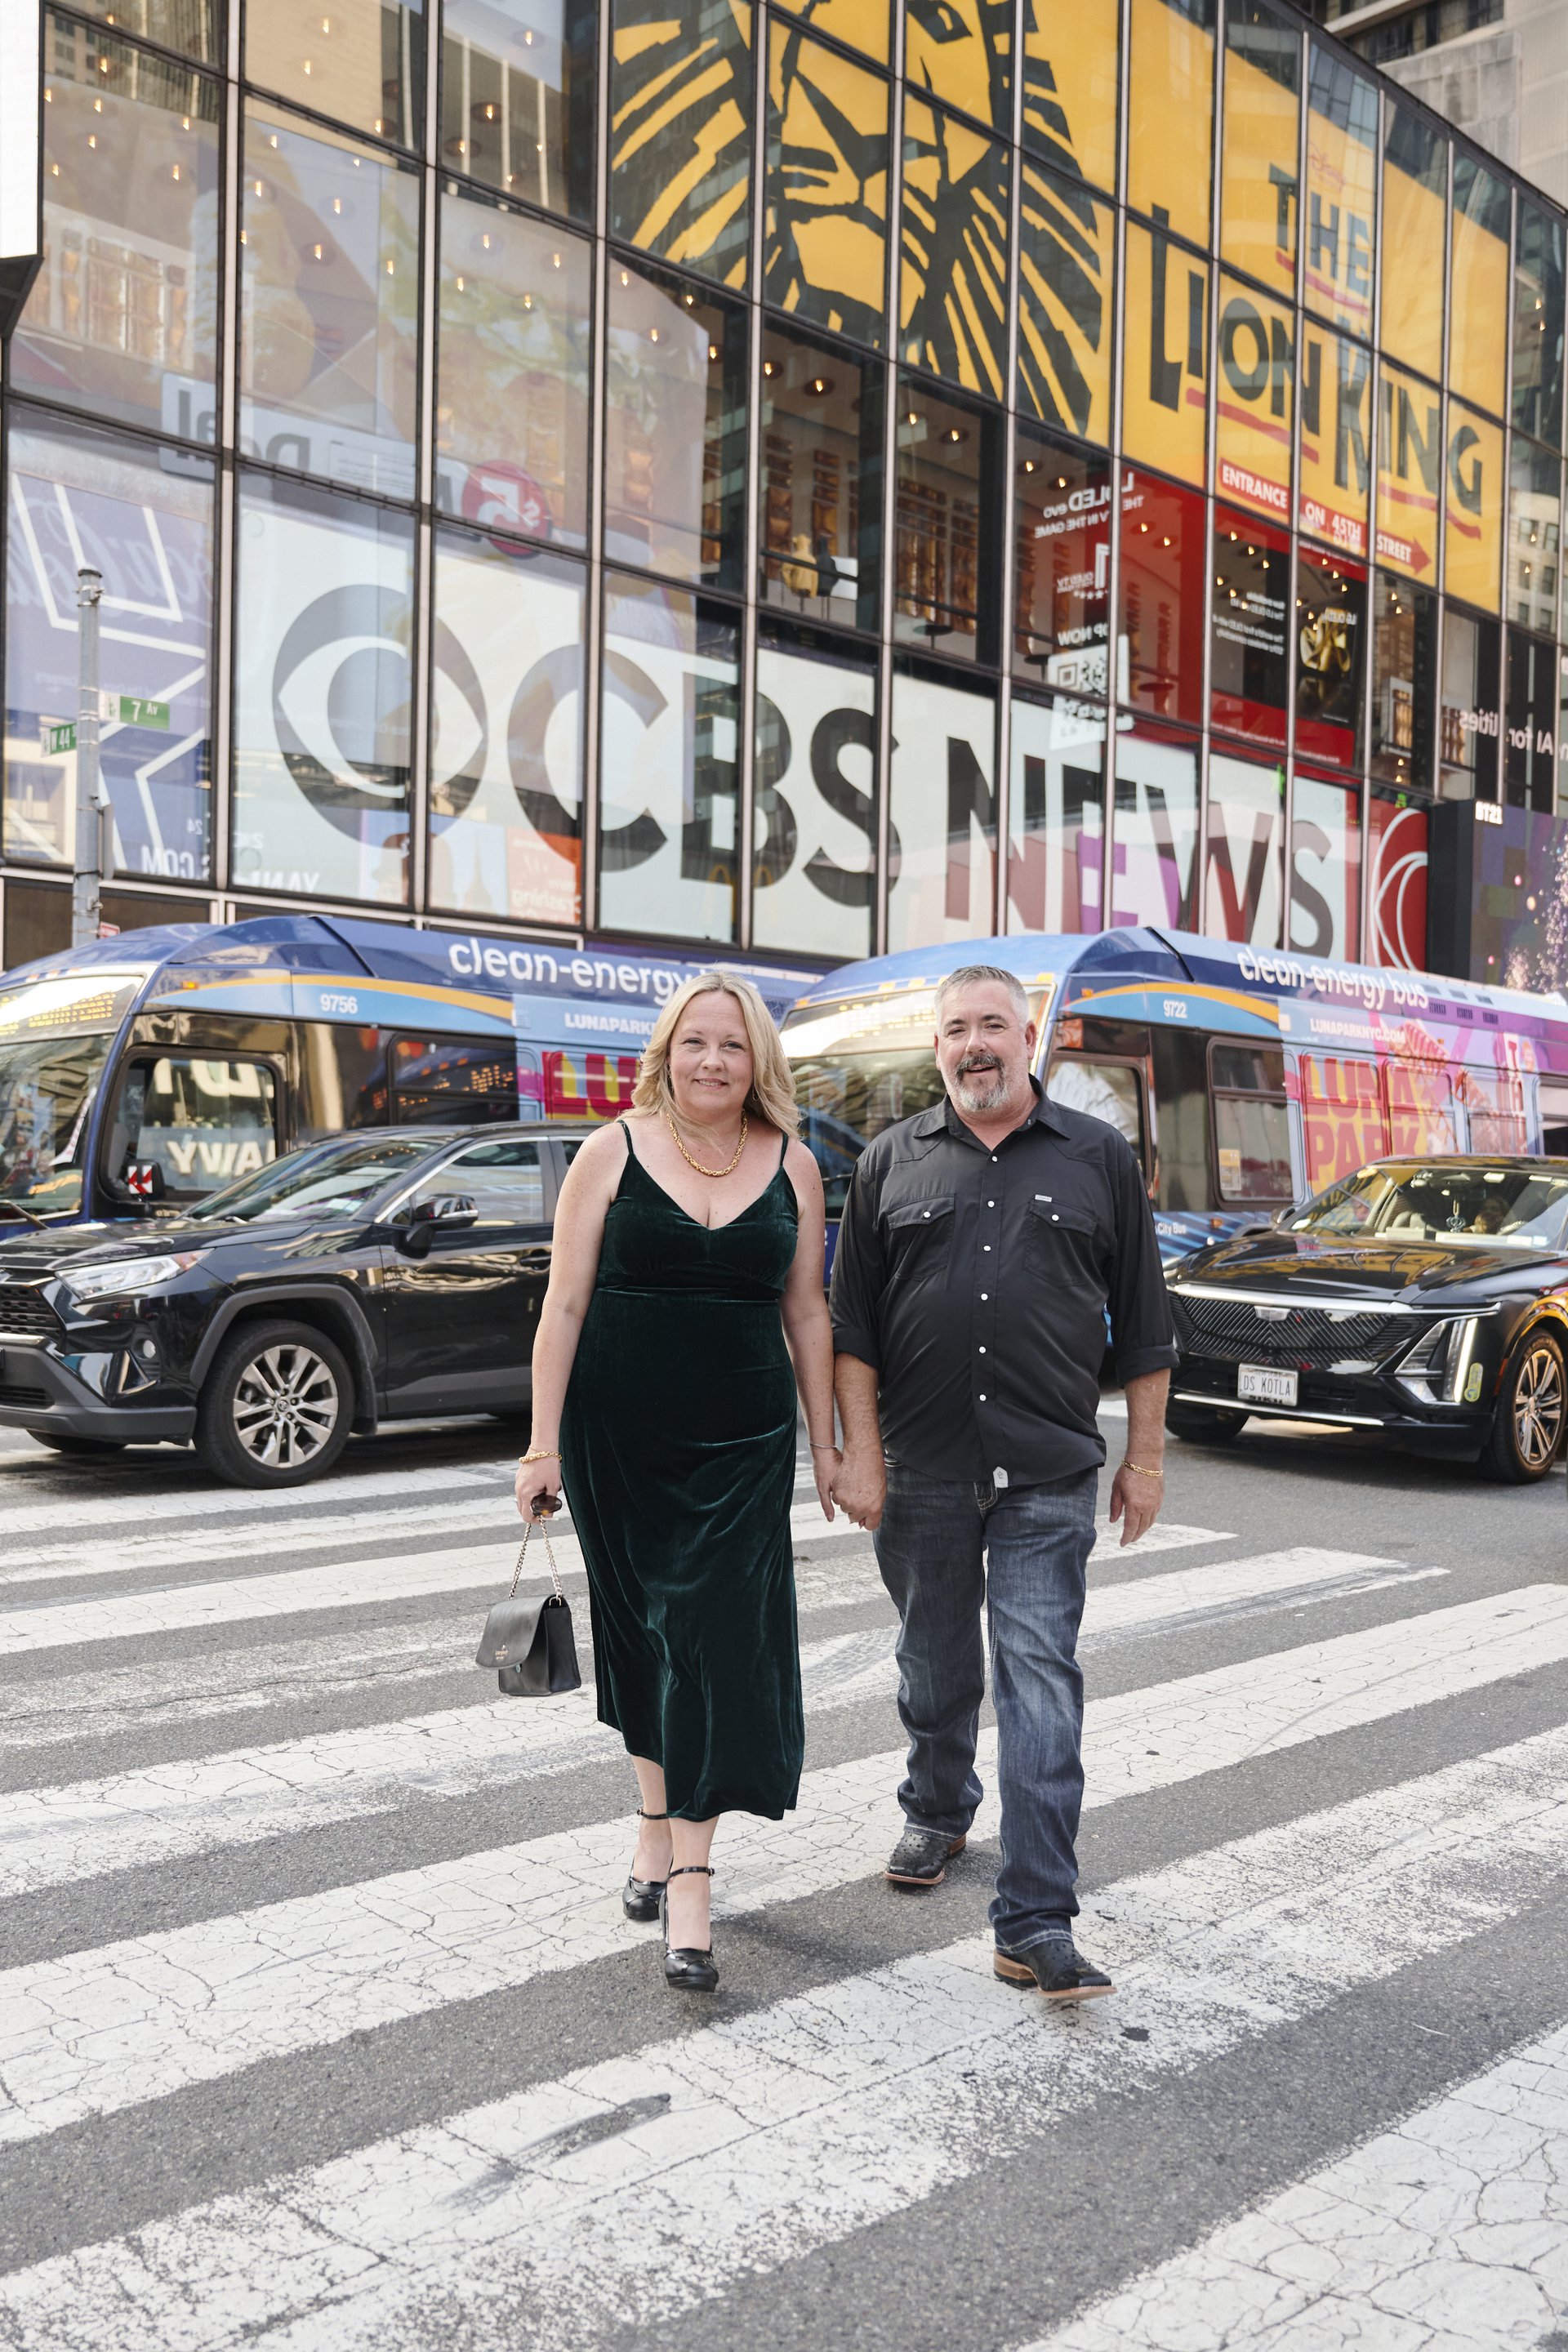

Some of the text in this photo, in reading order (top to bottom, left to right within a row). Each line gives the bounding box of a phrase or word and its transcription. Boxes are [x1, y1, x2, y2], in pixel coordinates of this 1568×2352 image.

[1269, 163, 1369, 298] THE
[1150, 203, 1321, 438] LION
[1334, 315, 1483, 517] KING
[1222, 464, 1289, 510] ENTRANCE
[1305, 502, 1325, 526] ON
[1332, 514, 1362, 538] 45TH
[1376, 534, 1411, 564] STREET
[131, 700, 158, 722] 7 Av
[59, 727, 70, 750] 44
[507, 644, 1334, 961] CBS NEWS
[1475, 800, 1503, 825] BT21
[449, 938, 691, 1006] clean-energy
[1236, 947, 1430, 1010] clean-energy bus
[319, 993, 358, 1014] 9756
[564, 1013, 656, 1036] LUNAPARK
[1163, 999, 1188, 1019] 9722
[1310, 1018, 1407, 1045] LUNAPARKNYC.COM
[1298, 1055, 1419, 1122] LUNA
[1304, 1120, 1421, 1183] PARK
[1157, 1222, 1187, 1236] City Bus
[1243, 1374, 1290, 1396] DS KOTLA
